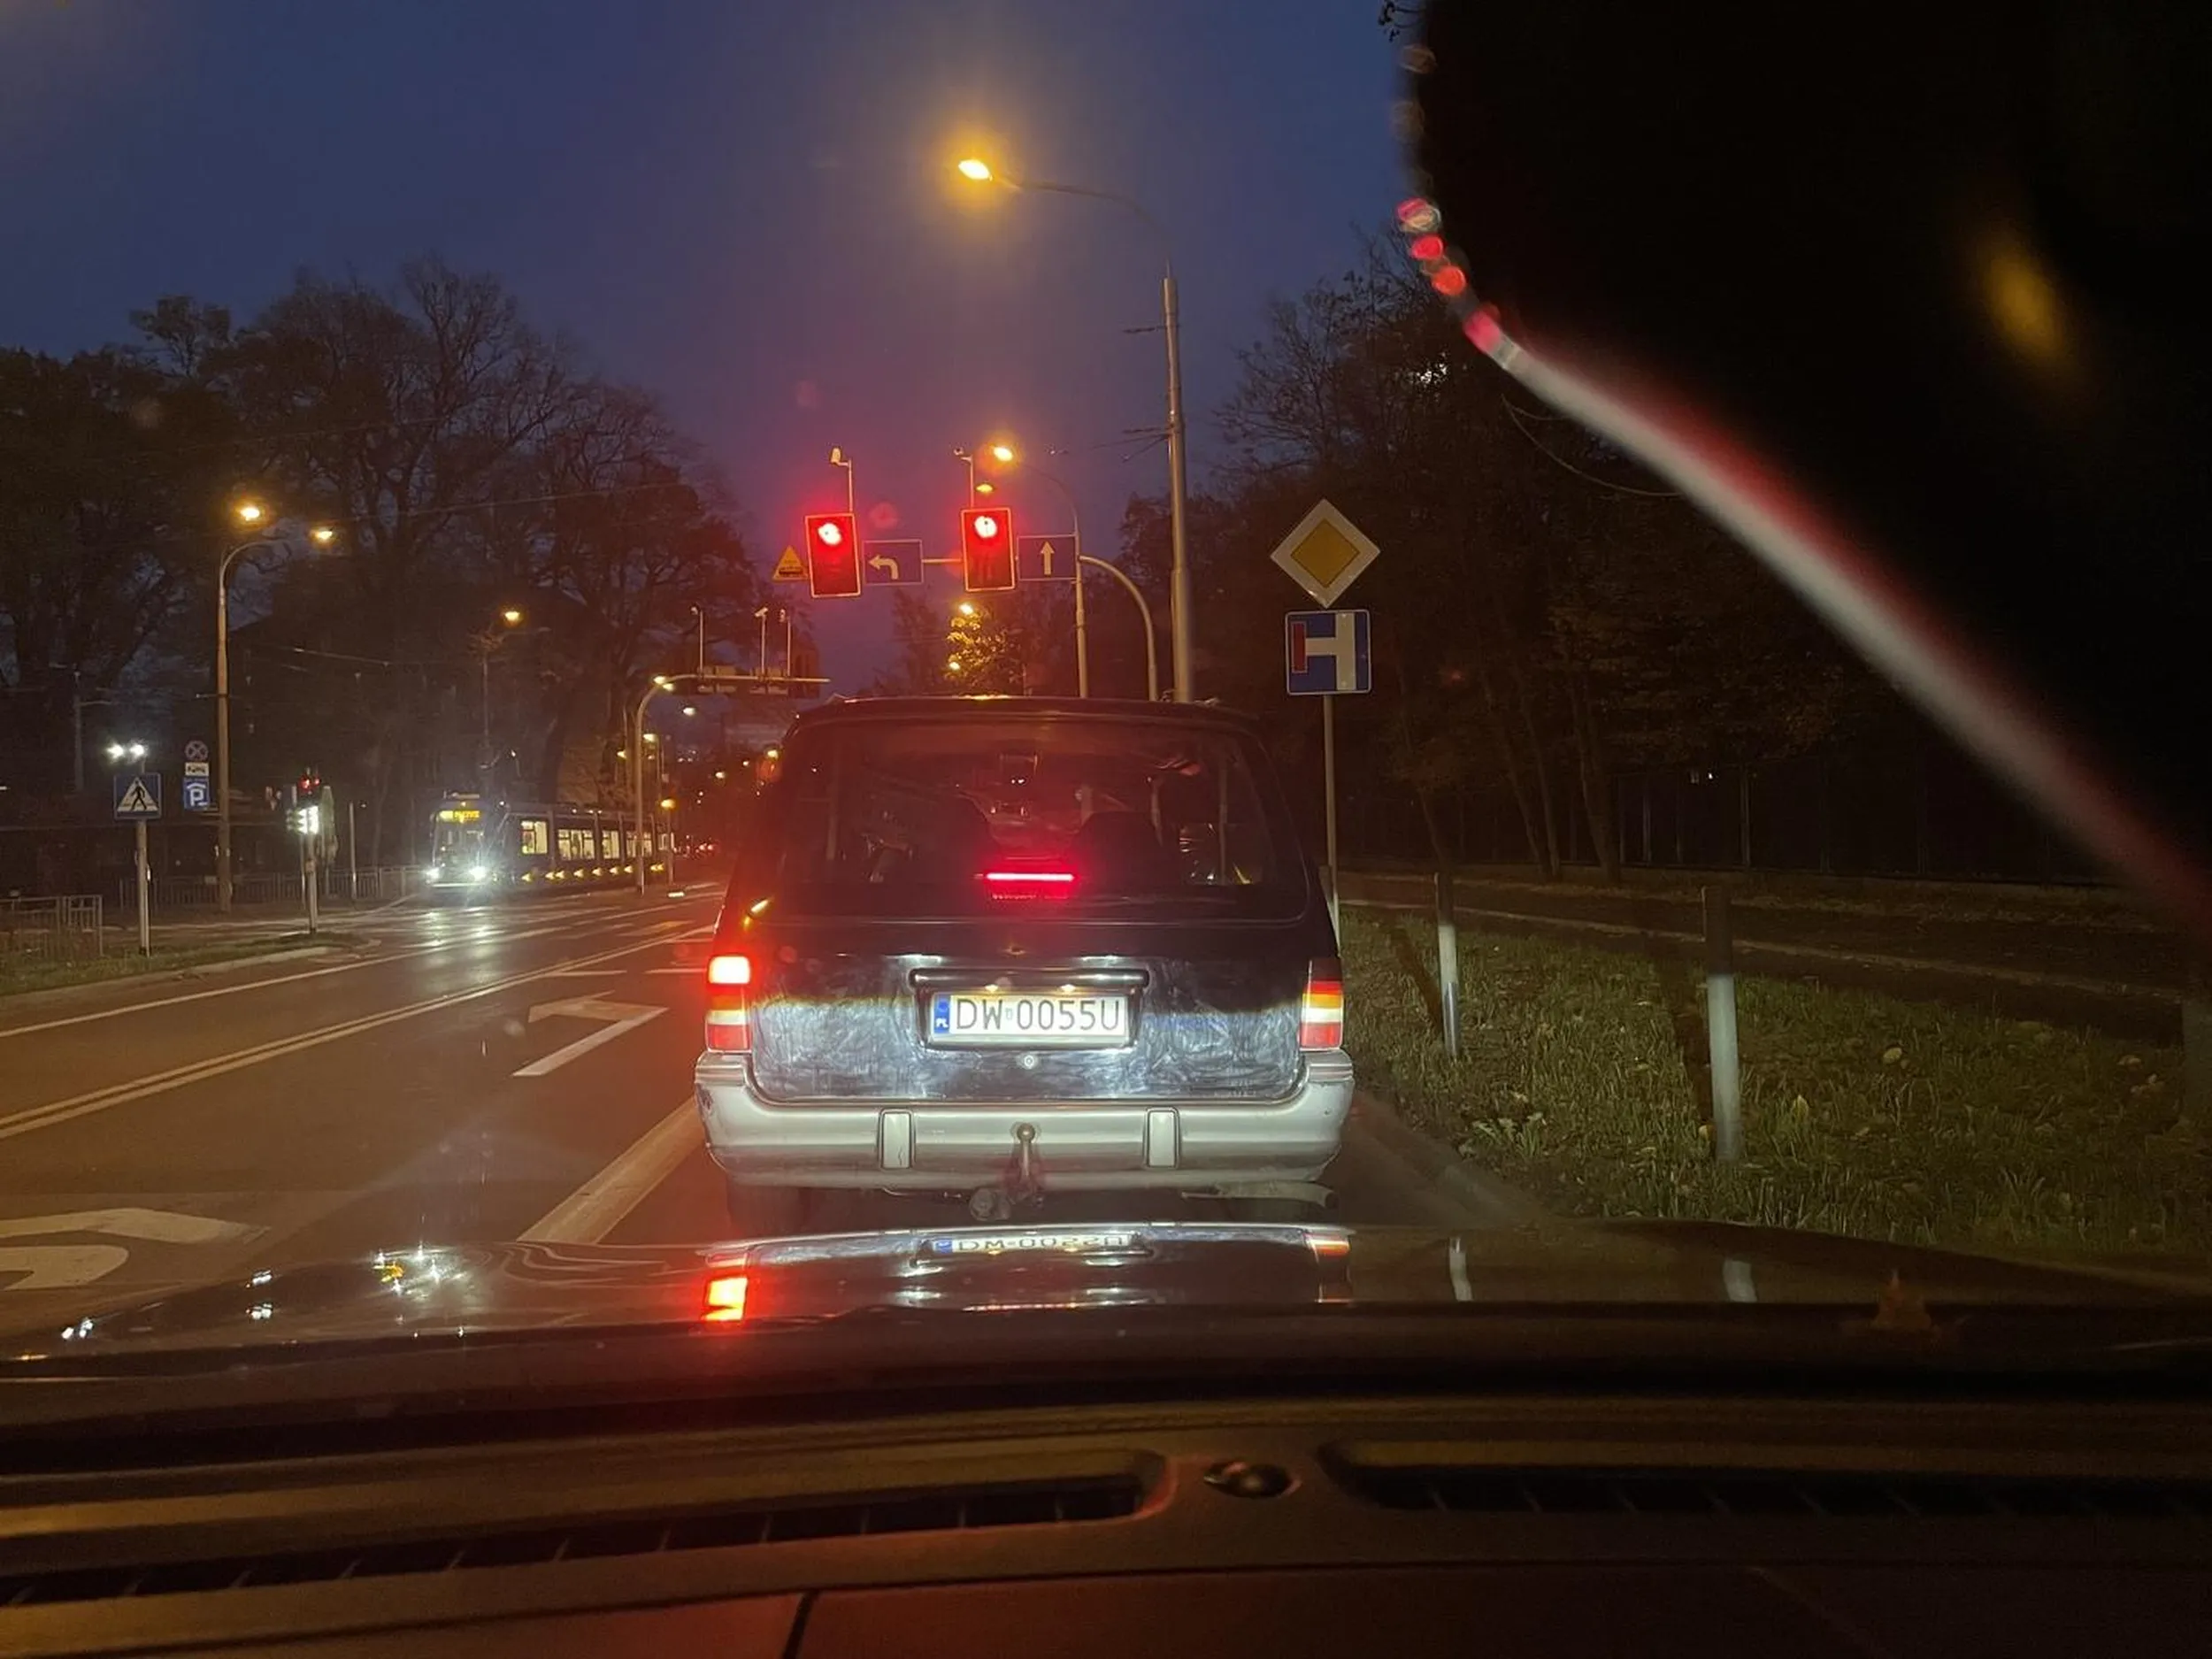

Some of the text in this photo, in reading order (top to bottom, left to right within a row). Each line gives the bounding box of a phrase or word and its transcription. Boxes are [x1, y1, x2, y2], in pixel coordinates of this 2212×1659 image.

[190, 788, 204, 807] P
[935, 1018, 949, 1028] PL
[956, 999, 1119, 1031] DW 0055U
